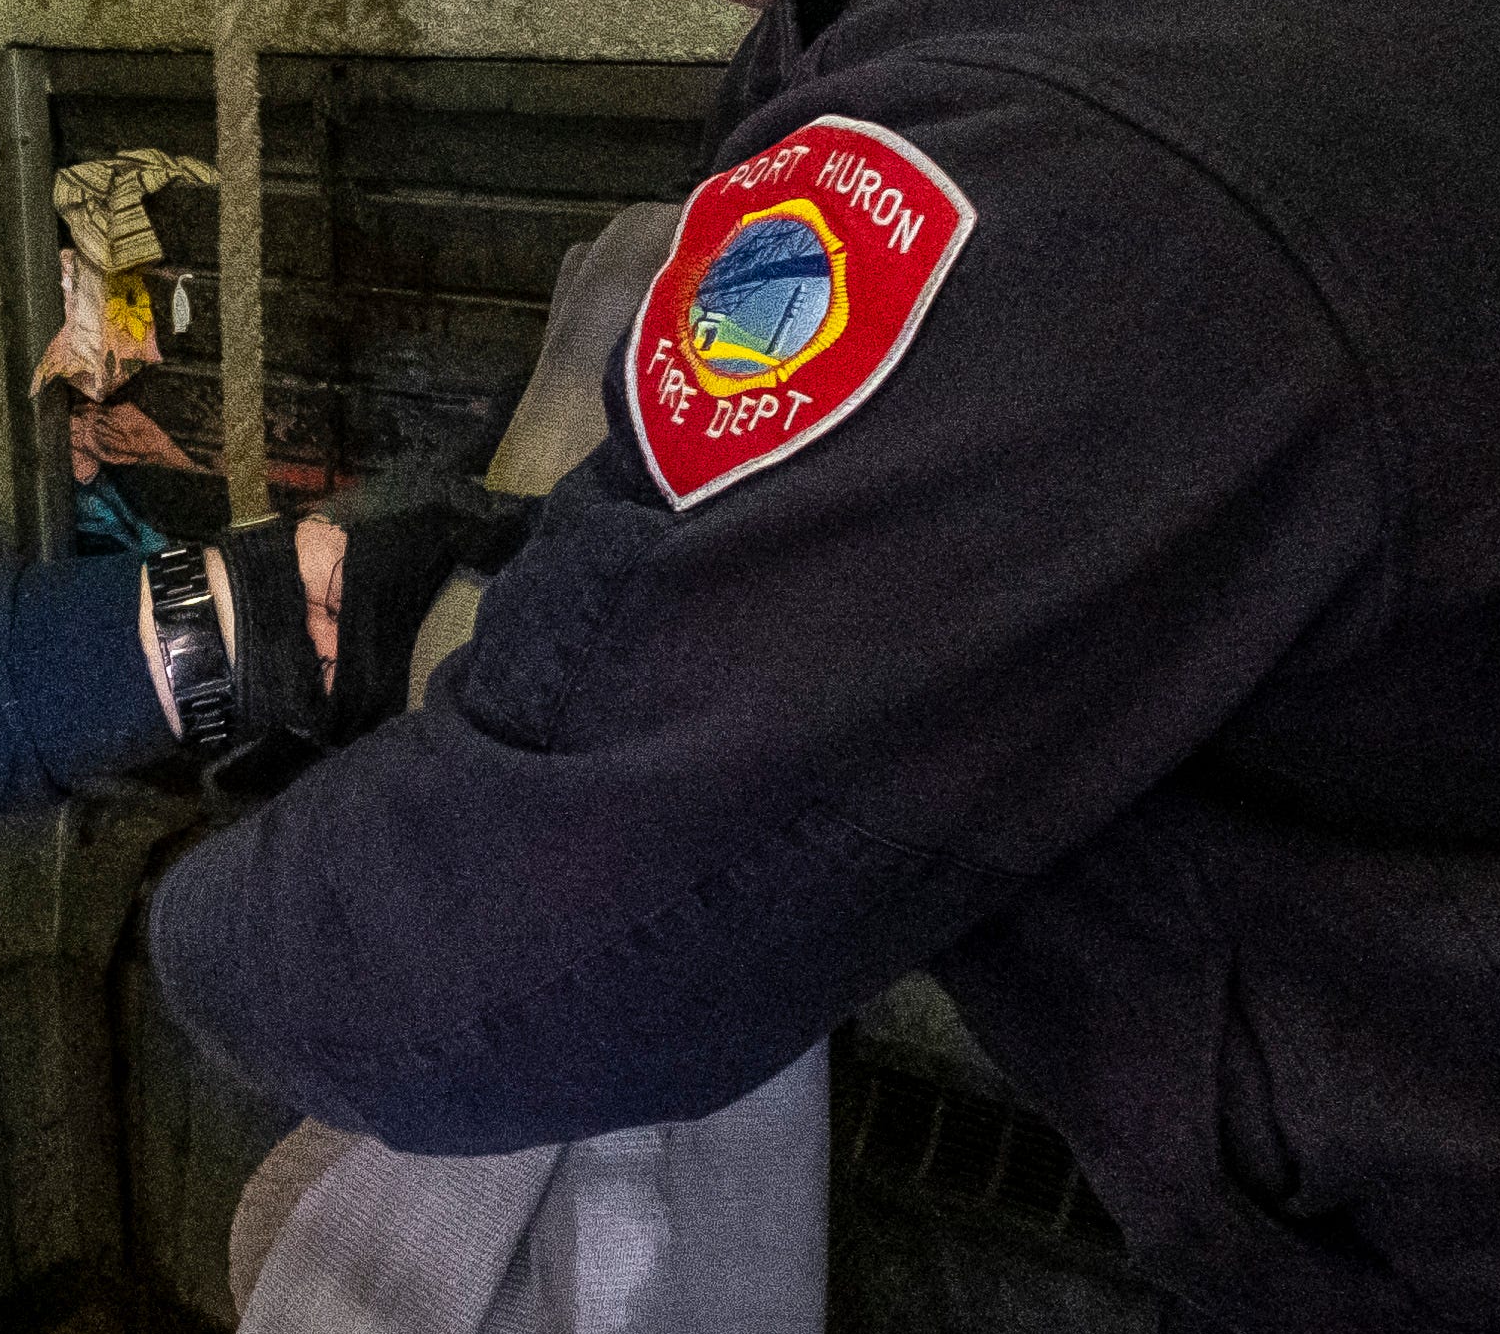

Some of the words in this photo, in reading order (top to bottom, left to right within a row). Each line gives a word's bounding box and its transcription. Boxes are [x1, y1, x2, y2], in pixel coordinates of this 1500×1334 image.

[719, 145, 810, 195] PORT
[815, 149, 925, 255] HURON
[645, 338, 698, 425] FIRE
[705, 389, 814, 439] DEPT
